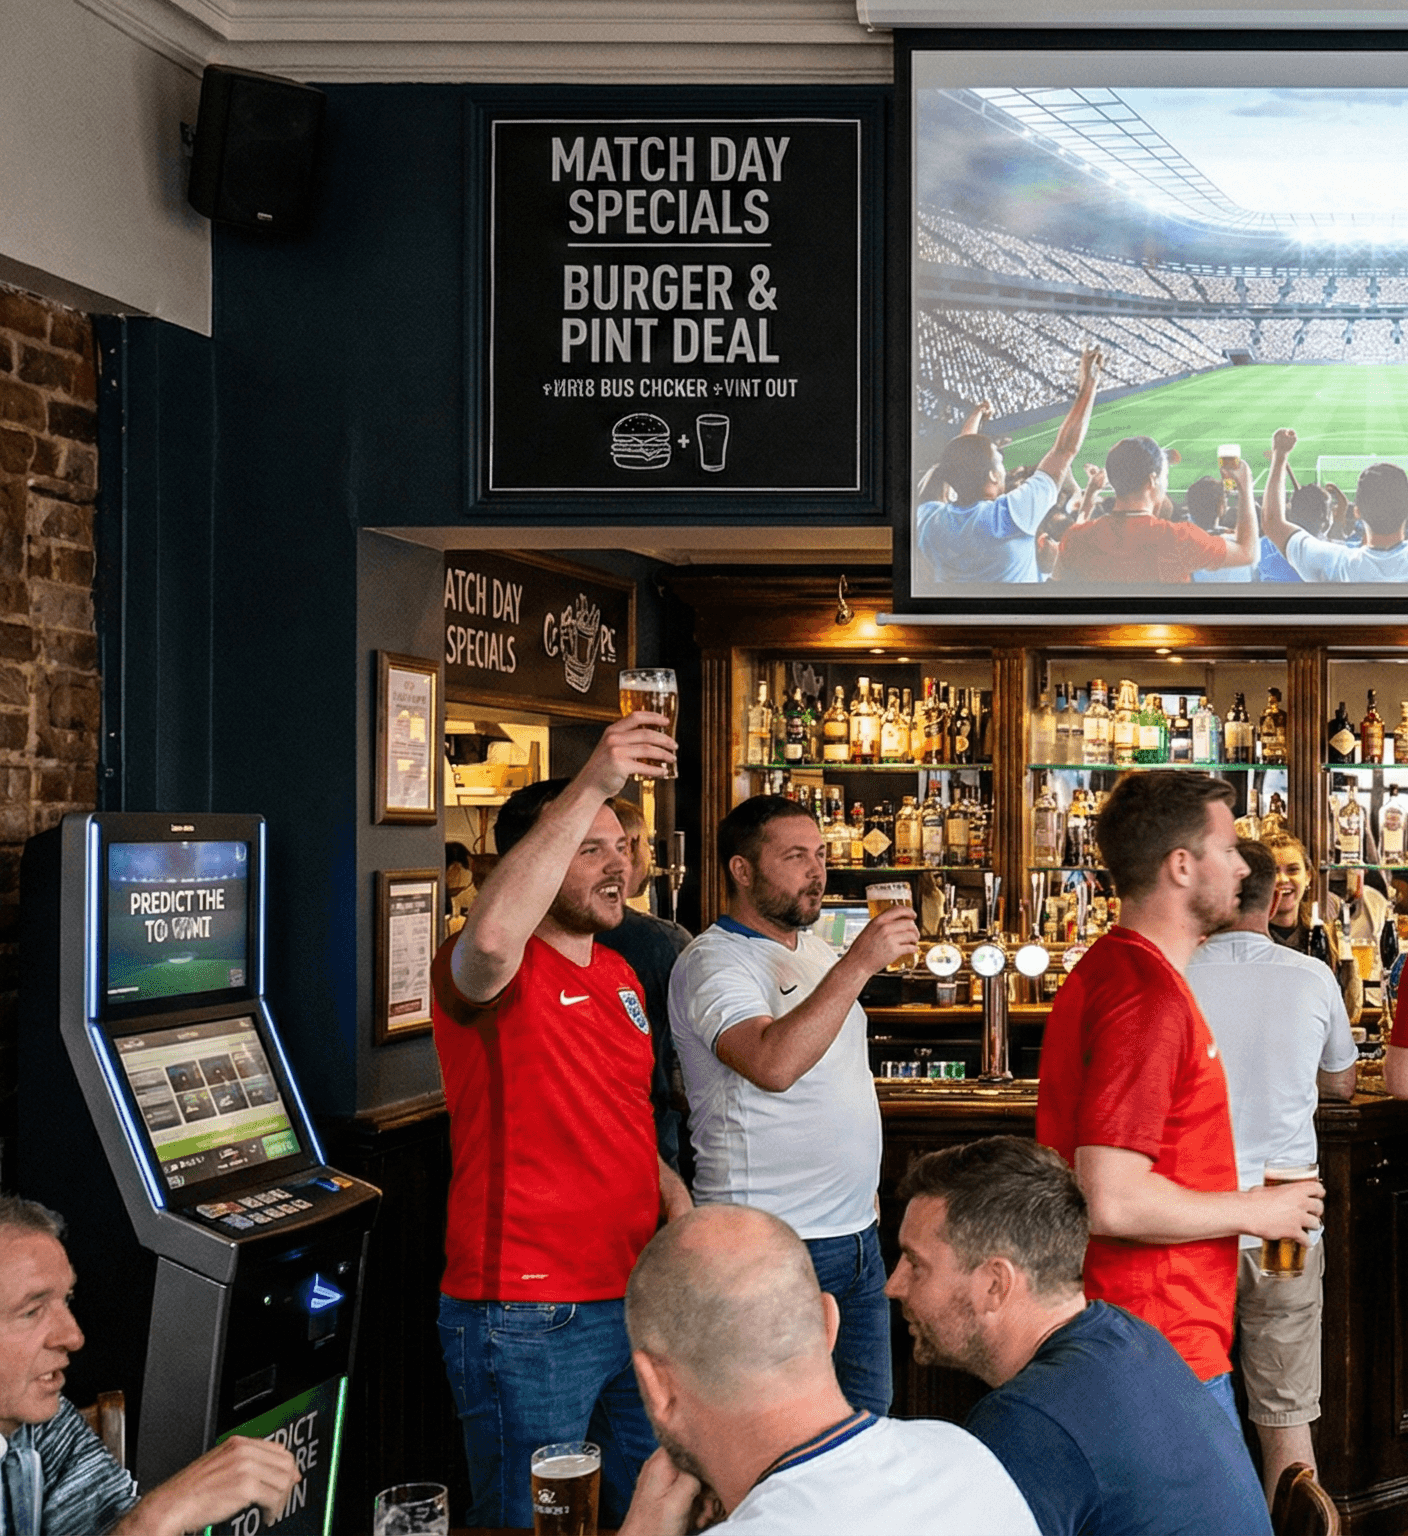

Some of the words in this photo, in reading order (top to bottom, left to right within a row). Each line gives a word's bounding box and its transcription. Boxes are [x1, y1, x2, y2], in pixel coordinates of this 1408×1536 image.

[551, 136, 695, 182] MATCH
[710, 136, 791, 182] DAY
[568, 188, 770, 235] SPECIALS
[564, 264, 734, 311] BURGER
[747, 263, 778, 311] &
[562, 317, 659, 363] PINT
[673, 317, 780, 363] DEAL
[600, 378, 635, 398] BUS
[639, 378, 708, 398] CHCKER
[765, 378, 798, 398] OUT
[444, 568, 487, 616] ATCH
[493, 578, 523, 625] DAY
[446, 624, 517, 674] SPECIALS
[130, 890, 195, 915] PREDICT
[196, 888, 225, 911] THE
[145, 918, 169, 943] TO
[264, 1410, 318, 1450] DICT
[231, 1508, 260, 1536] TO
